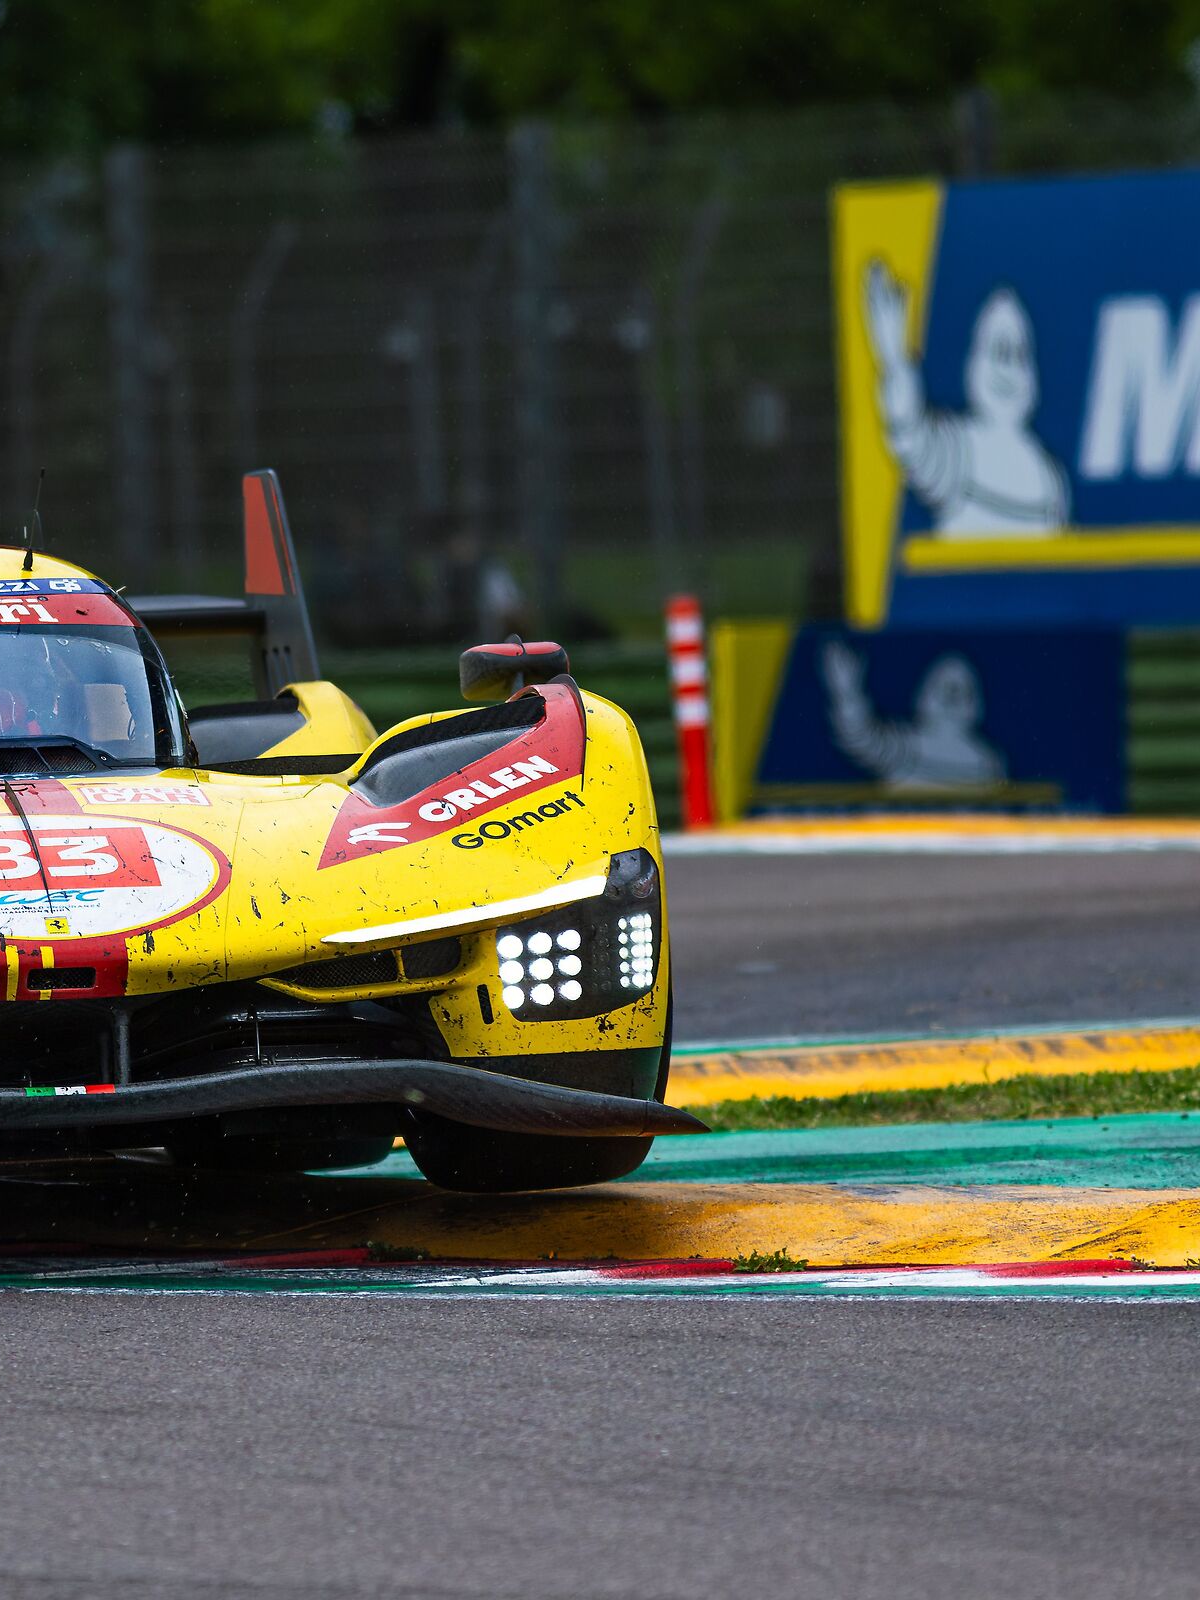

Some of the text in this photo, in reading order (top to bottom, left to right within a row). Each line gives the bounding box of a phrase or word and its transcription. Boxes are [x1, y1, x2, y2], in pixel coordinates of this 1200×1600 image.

[1080, 297, 1200, 481] M
[92, 792, 201, 804] CAR
[418, 755, 560, 822] ORLEN
[451, 791, 586, 849] GOmart
